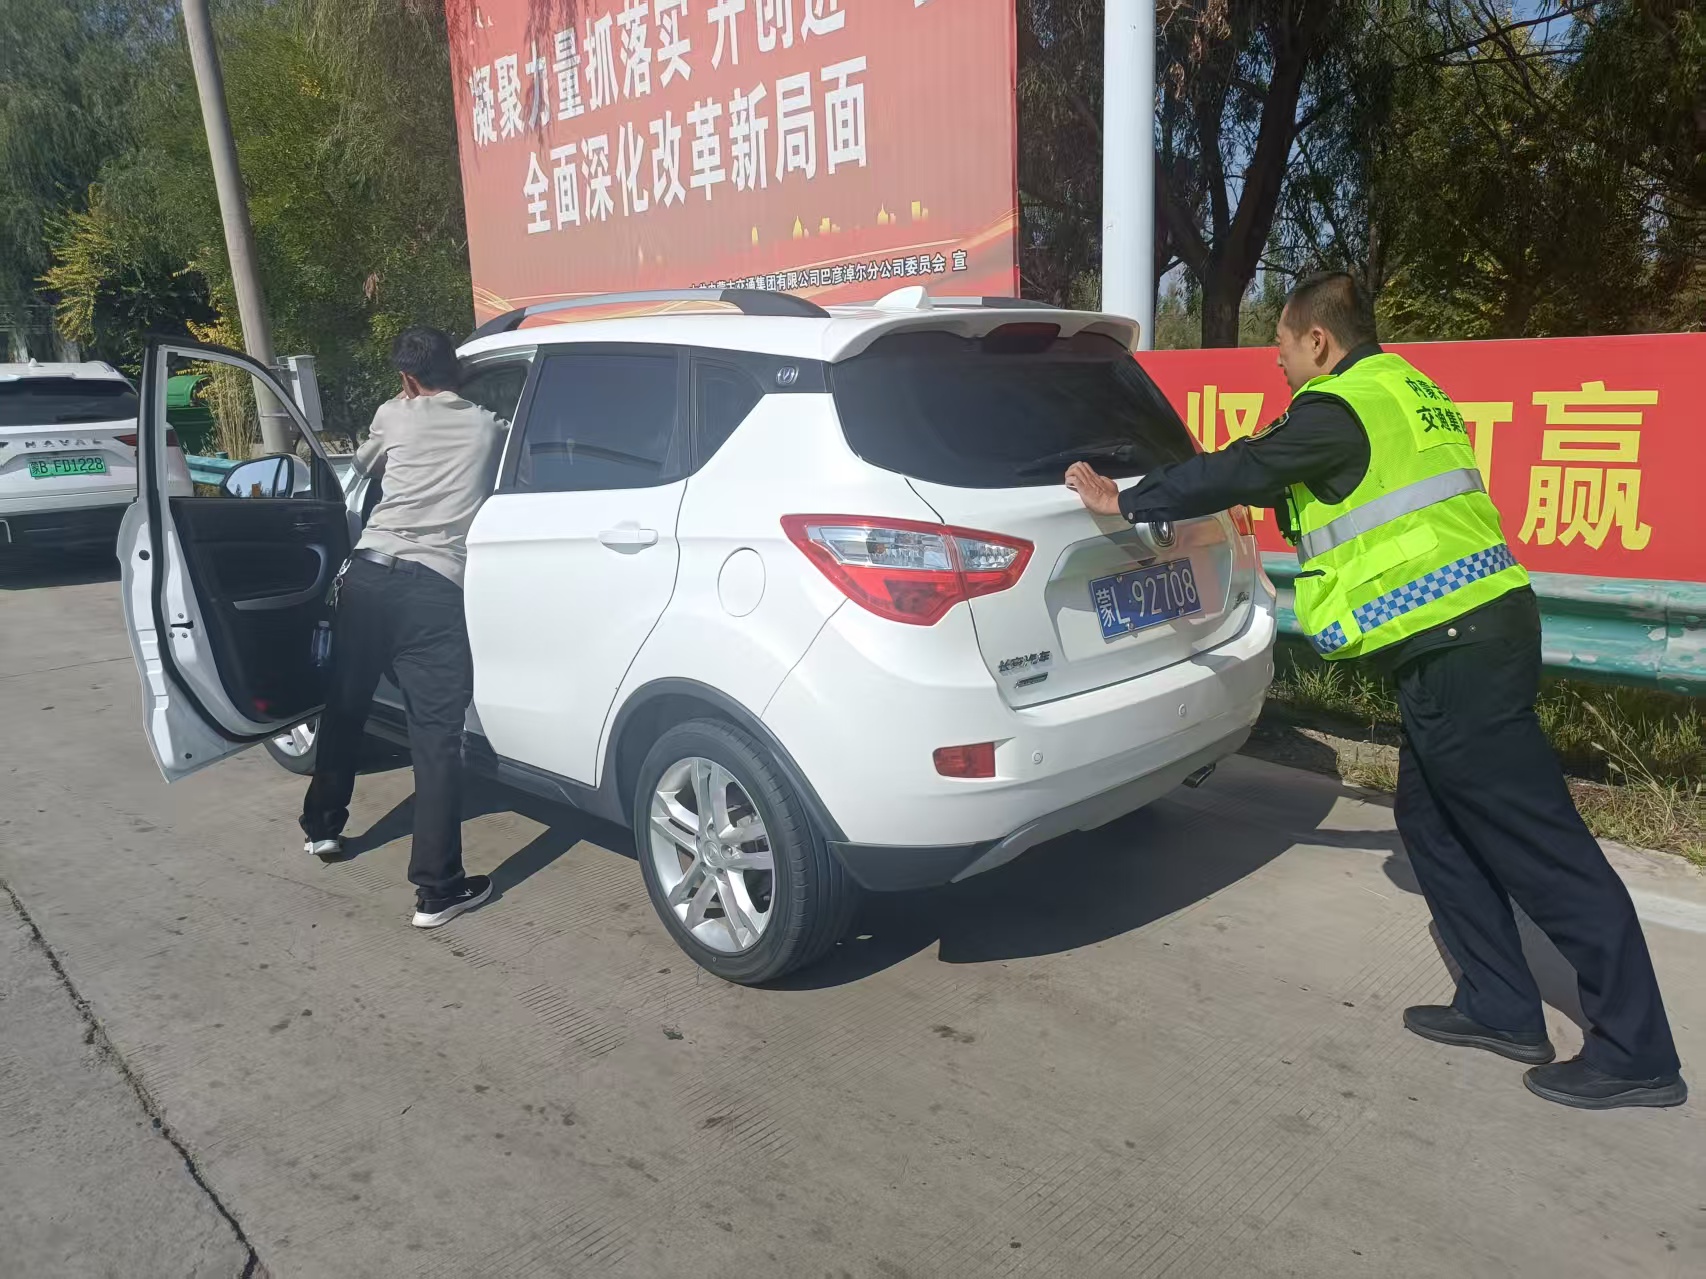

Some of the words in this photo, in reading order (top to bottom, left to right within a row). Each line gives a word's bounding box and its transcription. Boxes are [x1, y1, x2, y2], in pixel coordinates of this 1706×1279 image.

[522, 55, 868, 235] 全面深化改革新局面
[951, 250, 968, 272] 宣
[25, 438, 102, 448] HAVAL
